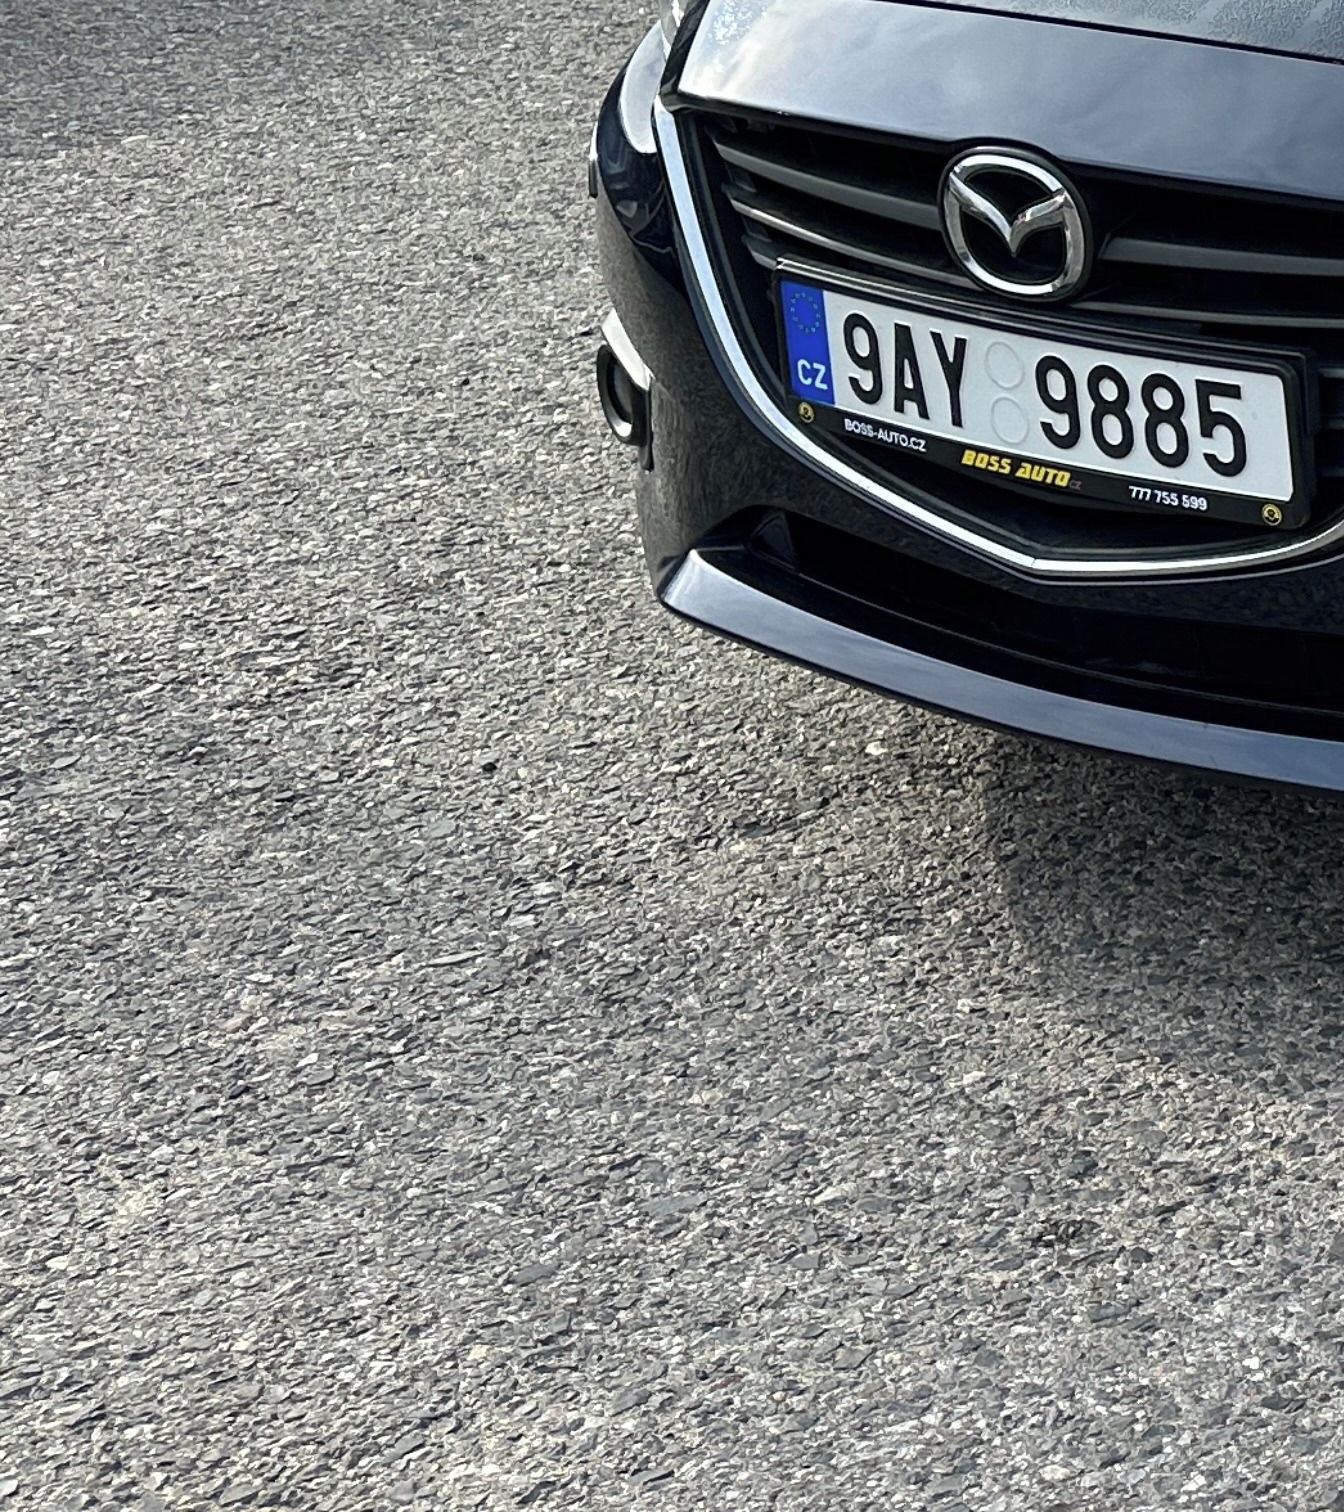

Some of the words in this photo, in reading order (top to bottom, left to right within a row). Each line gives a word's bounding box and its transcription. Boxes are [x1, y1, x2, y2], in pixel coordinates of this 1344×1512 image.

[797, 359, 828, 390] CZ
[843, 312, 968, 428] 9AY
[1034, 355, 1248, 478] 9885
[844, 418, 927, 453] BOSS-AUTO.CZ
[961, 449, 1011, 474] BOSS
[1015, 462, 1071, 487] AUTO
[1129, 485, 1151, 501] 777
[1154, 490, 1178, 506] 755
[1182, 494, 1207, 511] 599
